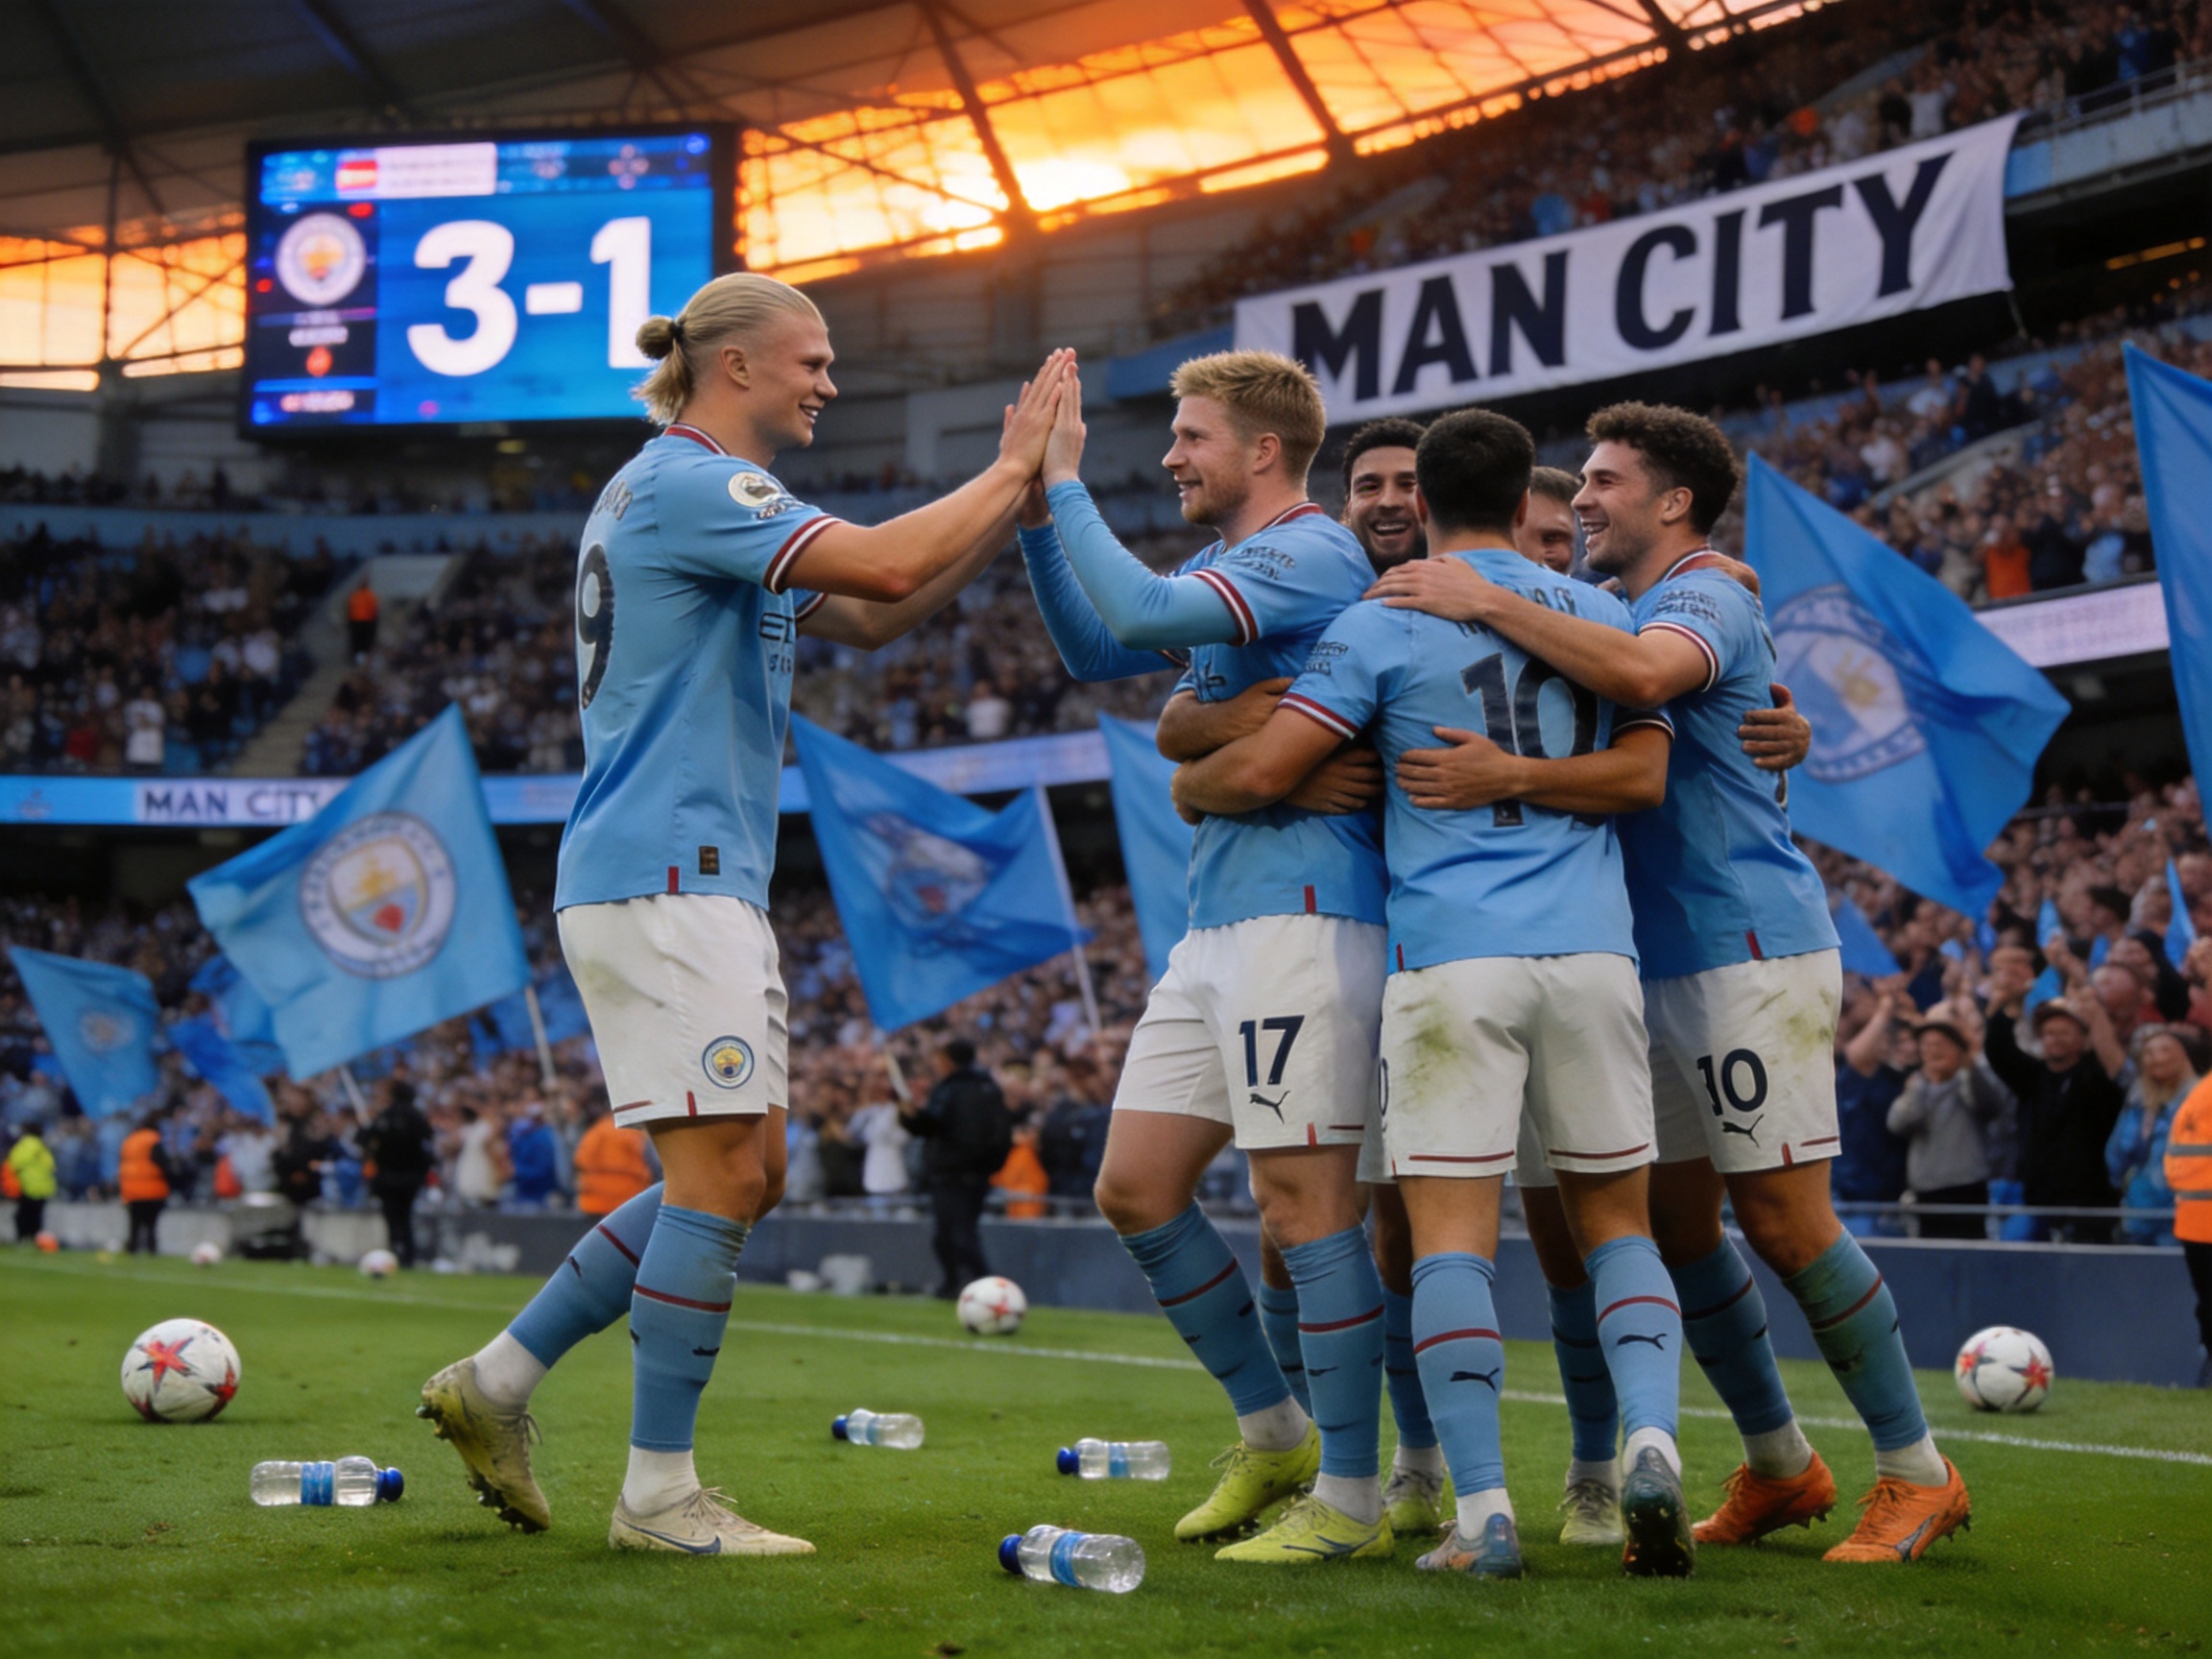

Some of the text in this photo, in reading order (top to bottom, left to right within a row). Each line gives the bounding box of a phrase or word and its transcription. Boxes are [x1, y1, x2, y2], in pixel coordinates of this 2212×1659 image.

[407, 216, 651, 377] 3-1
[1290, 151, 1955, 403] MAN CITY
[578, 543, 615, 710] 9
[145, 790, 228, 816] MAN
[1460, 653, 1600, 828] 10
[1238, 1015, 1305, 1087] 17
[1696, 1047, 1768, 1117] 10
